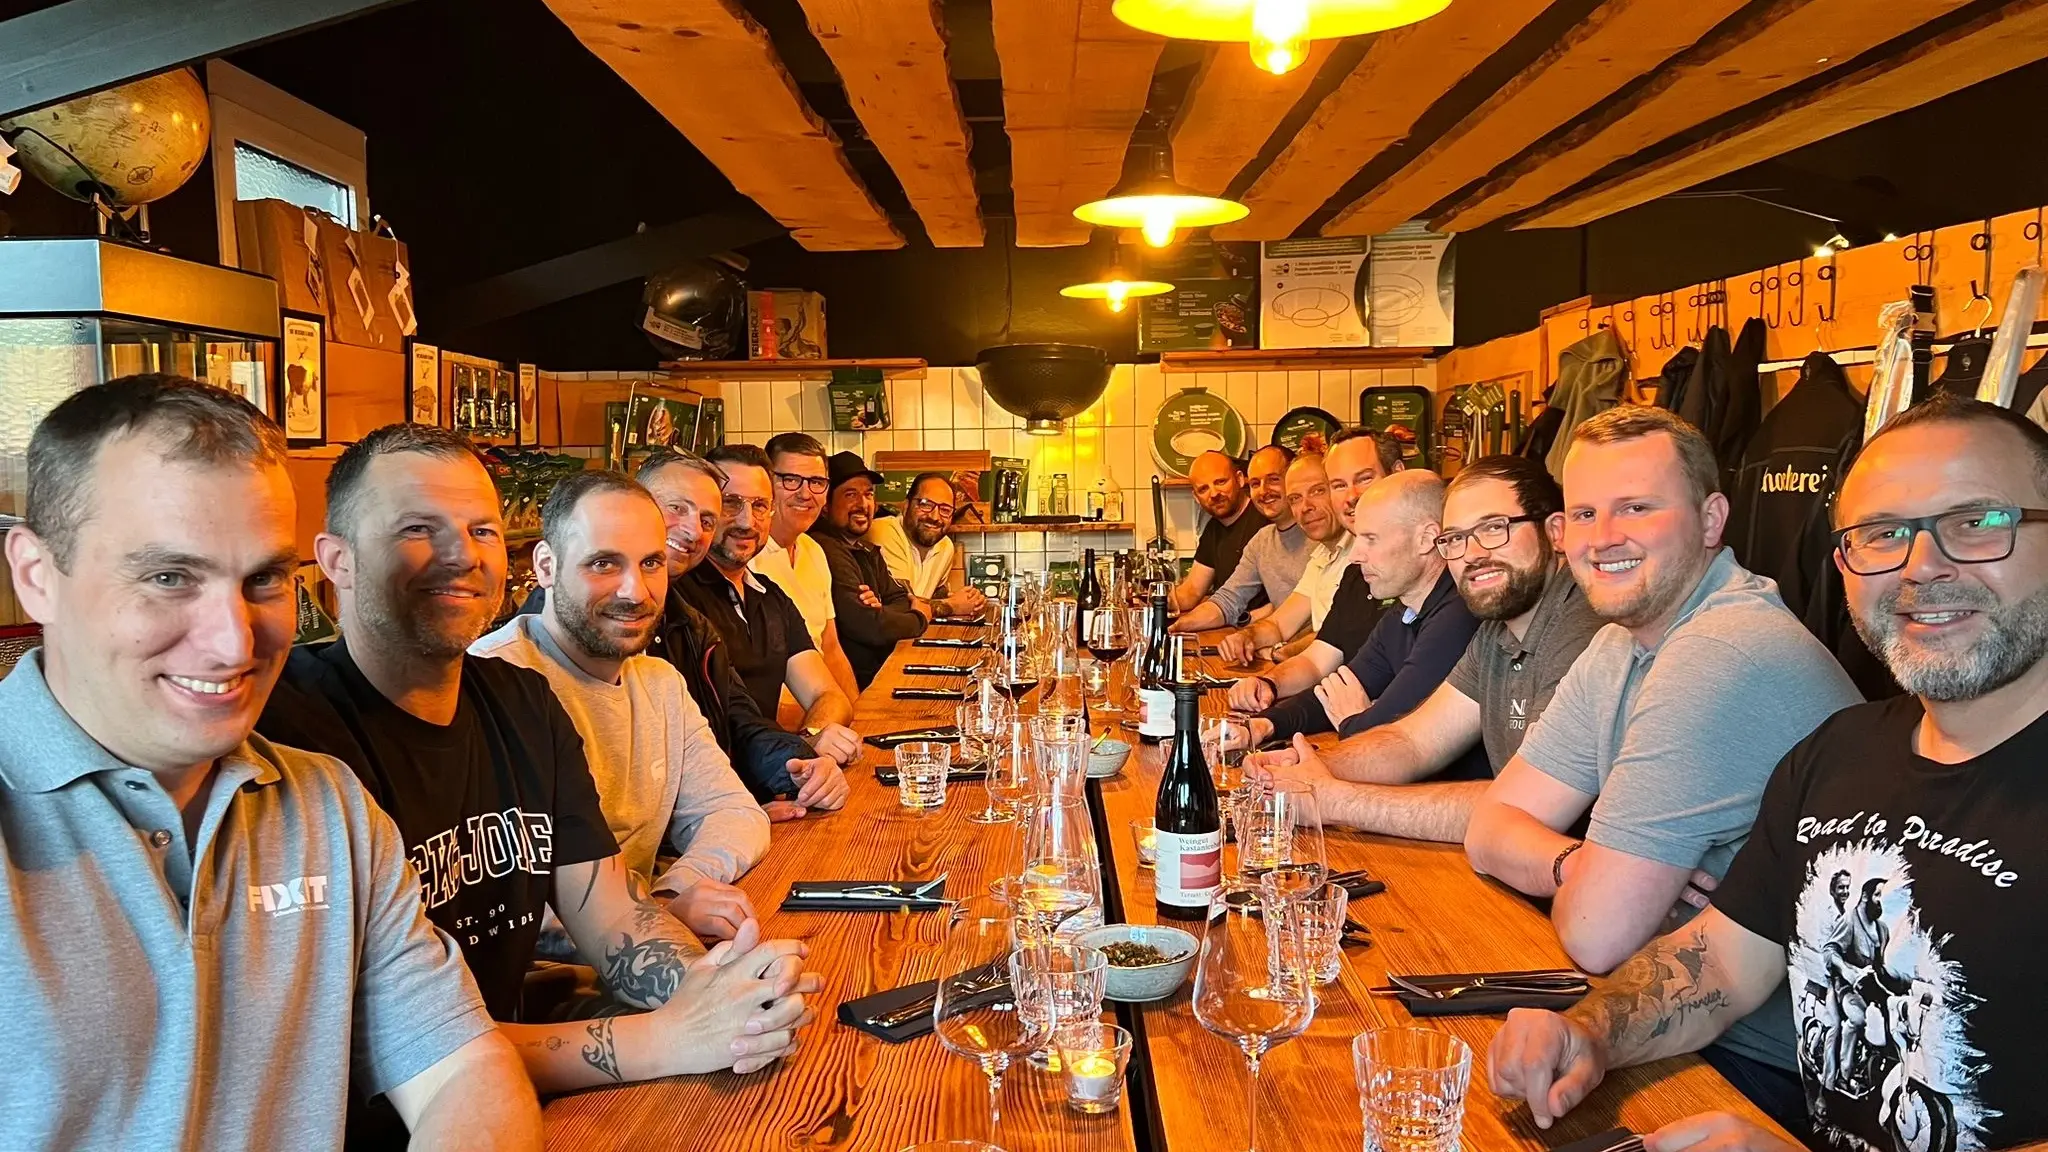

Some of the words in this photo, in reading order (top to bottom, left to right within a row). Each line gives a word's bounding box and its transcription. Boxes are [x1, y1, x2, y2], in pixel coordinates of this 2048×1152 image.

[1796, 810, 1865, 844] Road
[1863, 812, 1888, 836] to
[1898, 815, 2019, 888] Paradise
[489, 903, 505, 919] 90
